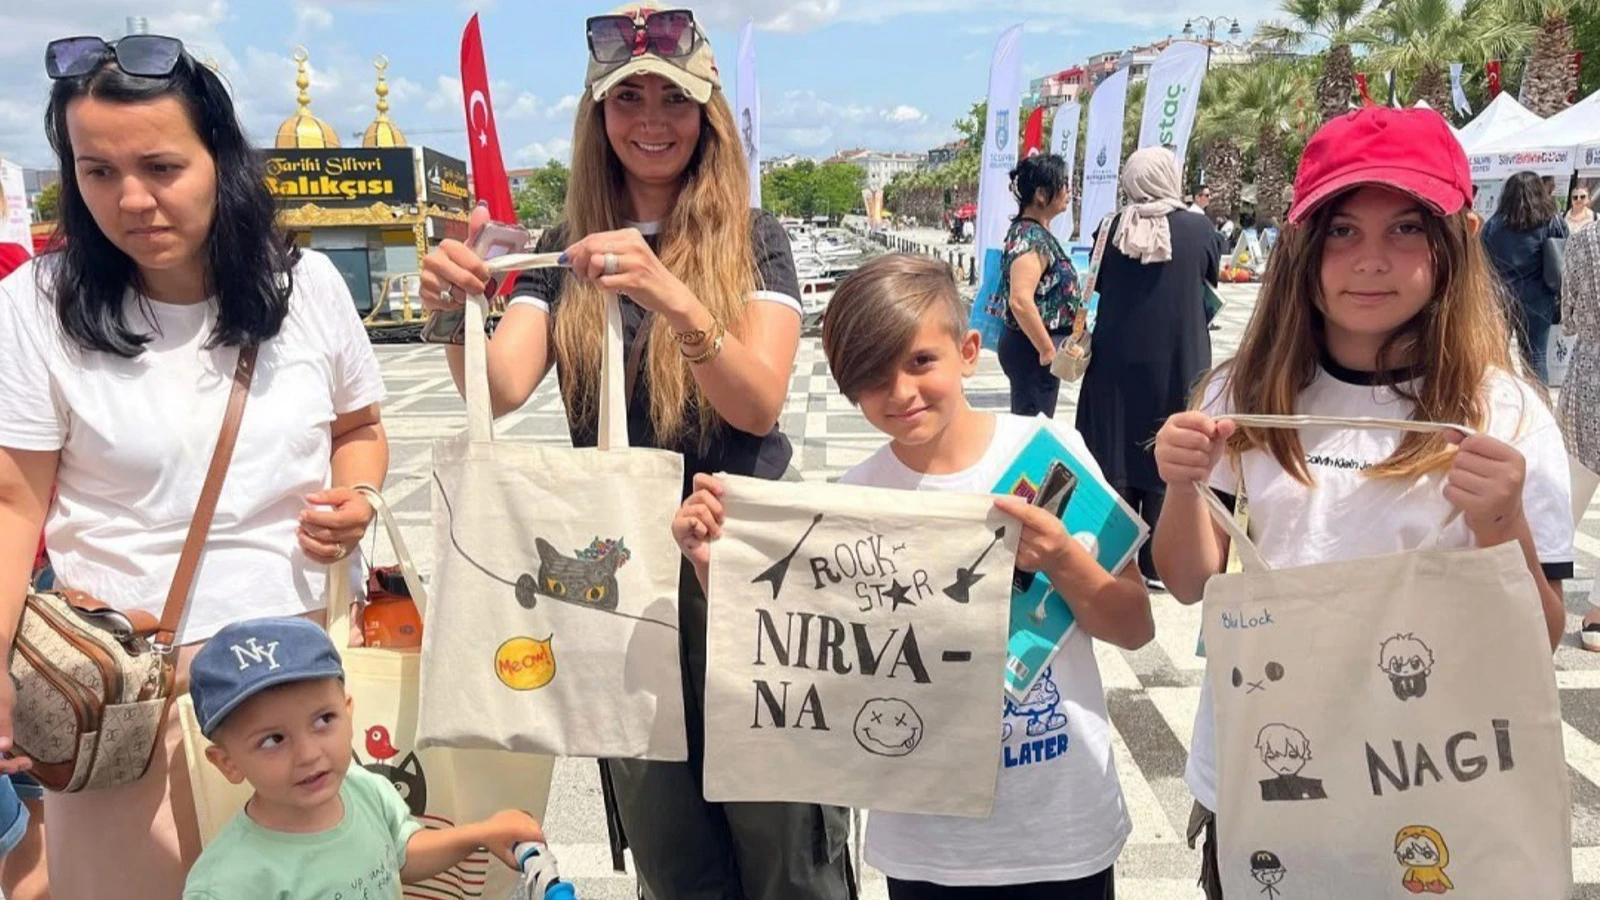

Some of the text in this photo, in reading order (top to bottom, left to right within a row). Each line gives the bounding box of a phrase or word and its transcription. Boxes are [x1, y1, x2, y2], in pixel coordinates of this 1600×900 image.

[1158, 84, 1186, 145] staç
[266, 157, 381, 175] Tarihi Silivri
[230, 637, 281, 671] NY
[750, 680, 830, 731] NA
[1004, 734, 1068, 768] LATER
